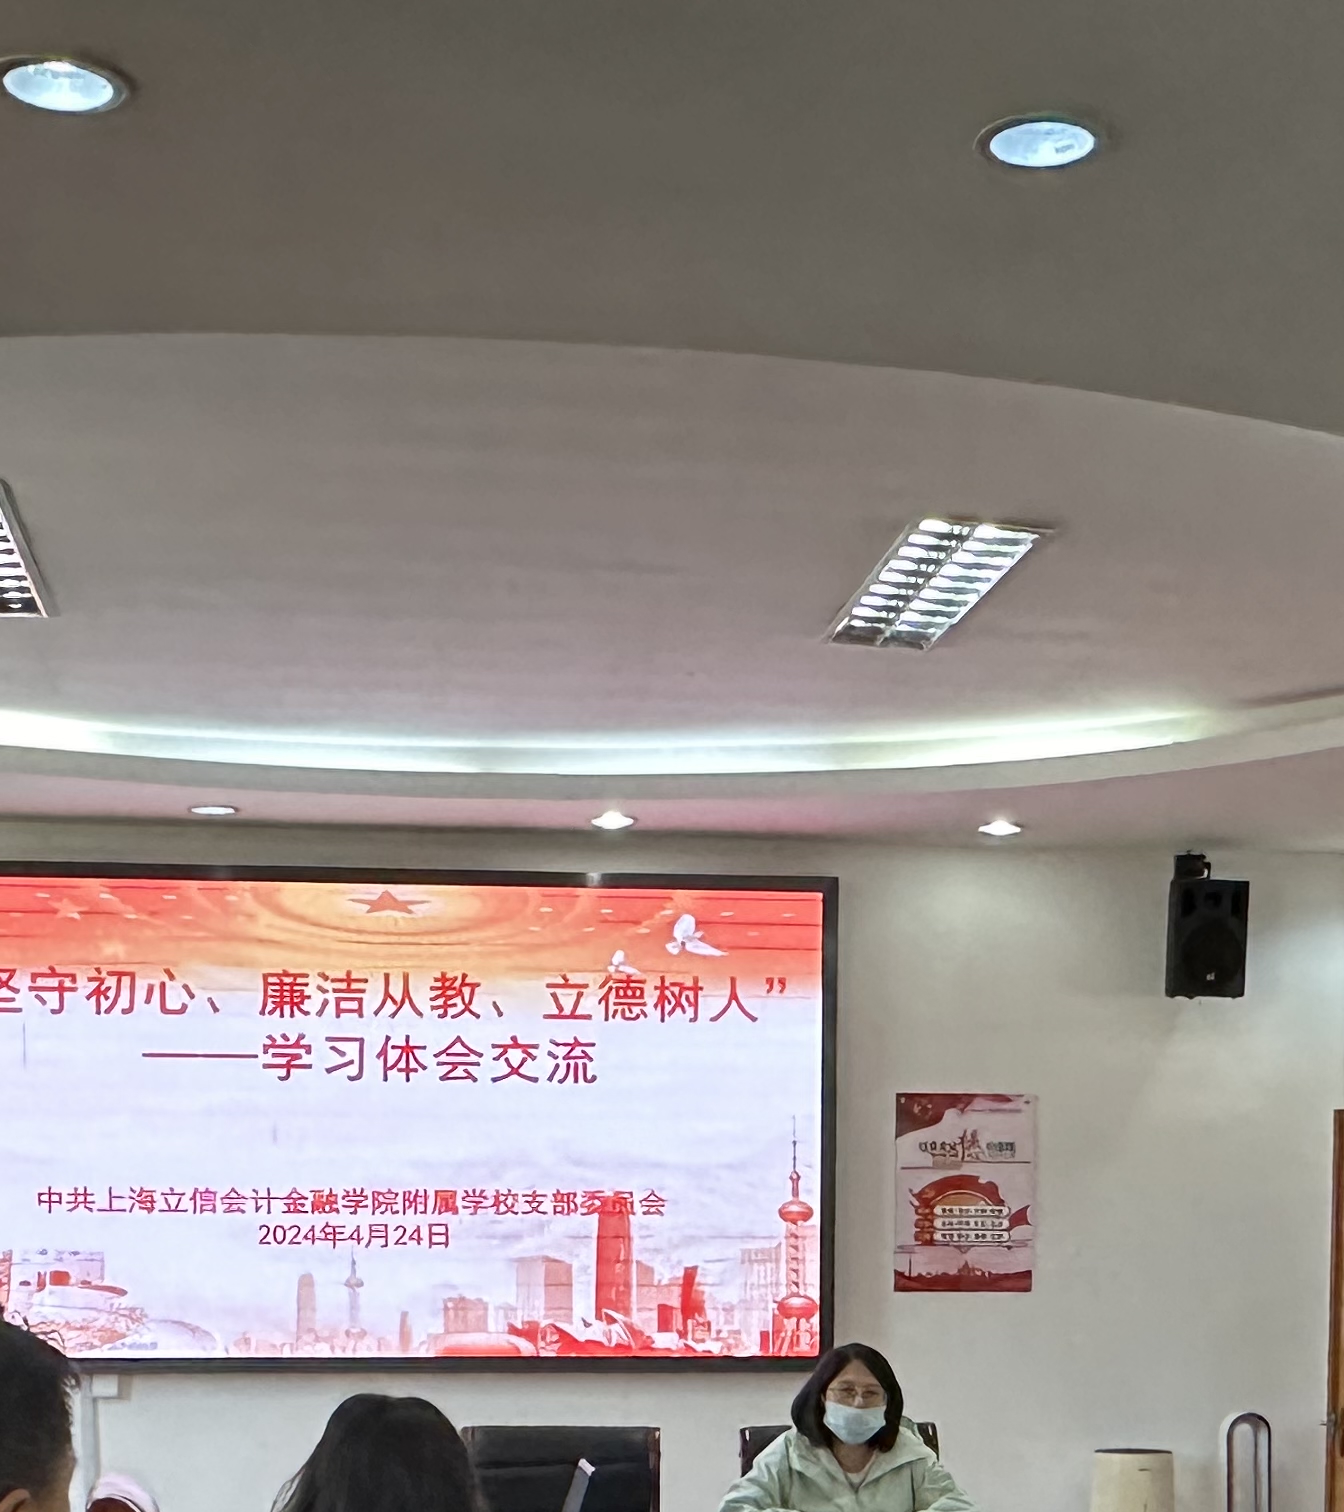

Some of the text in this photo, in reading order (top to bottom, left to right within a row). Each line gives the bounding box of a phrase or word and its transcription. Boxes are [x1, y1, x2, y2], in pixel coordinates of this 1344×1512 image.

[37, 1186, 668, 1217] 中共上海立信会计金融学院附属学校支部委员会
[258, 1221, 450, 1249] 2024年4月24日
